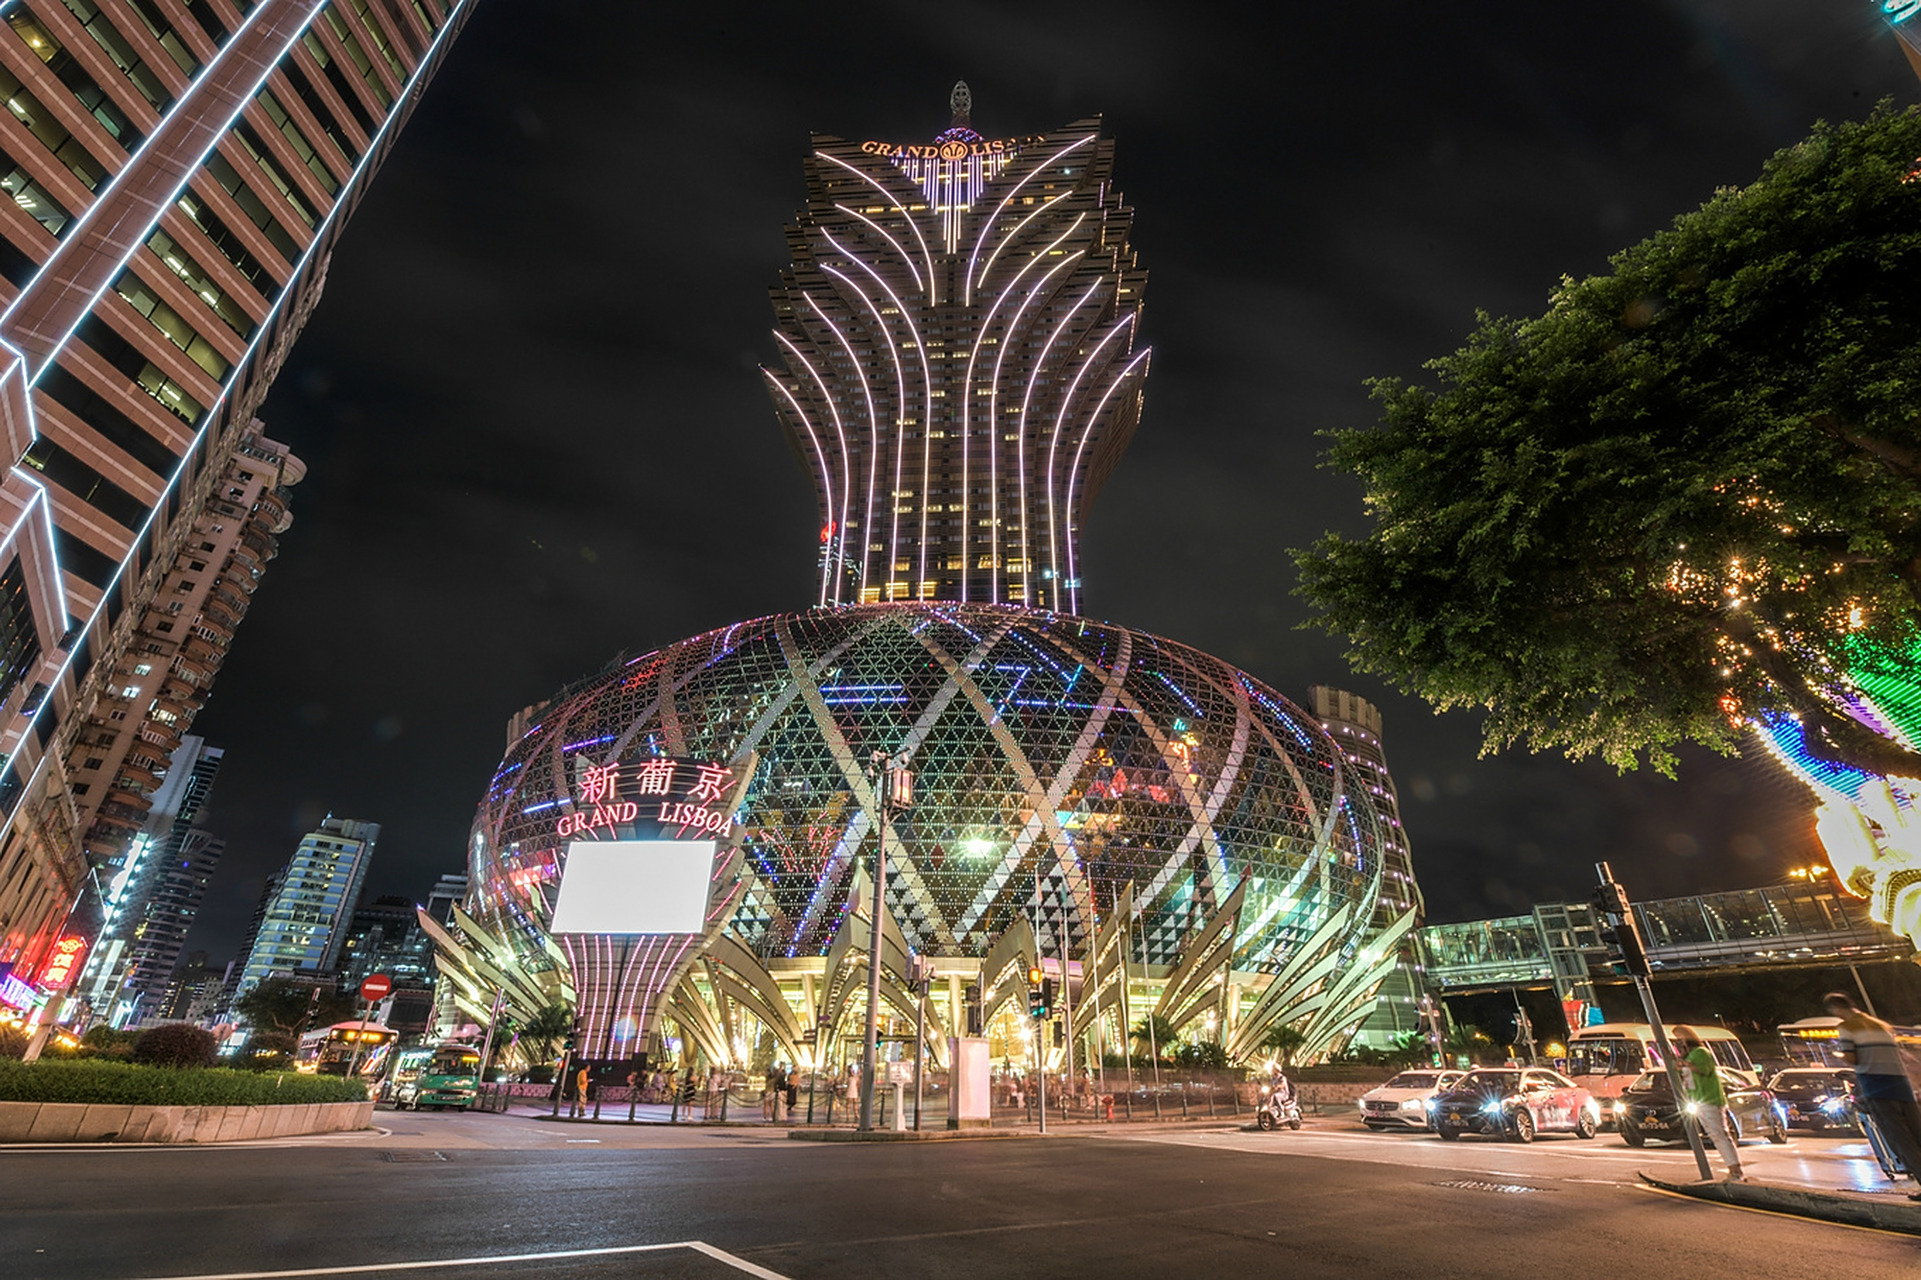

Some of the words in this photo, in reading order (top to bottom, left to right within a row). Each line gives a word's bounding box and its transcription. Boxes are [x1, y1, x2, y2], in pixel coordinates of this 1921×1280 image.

[861, 140, 939, 159] GRAND
[579, 758, 733, 804] 新葡京
[557, 801, 638, 837] GRAND
[657, 801, 733, 838] LISBOA
